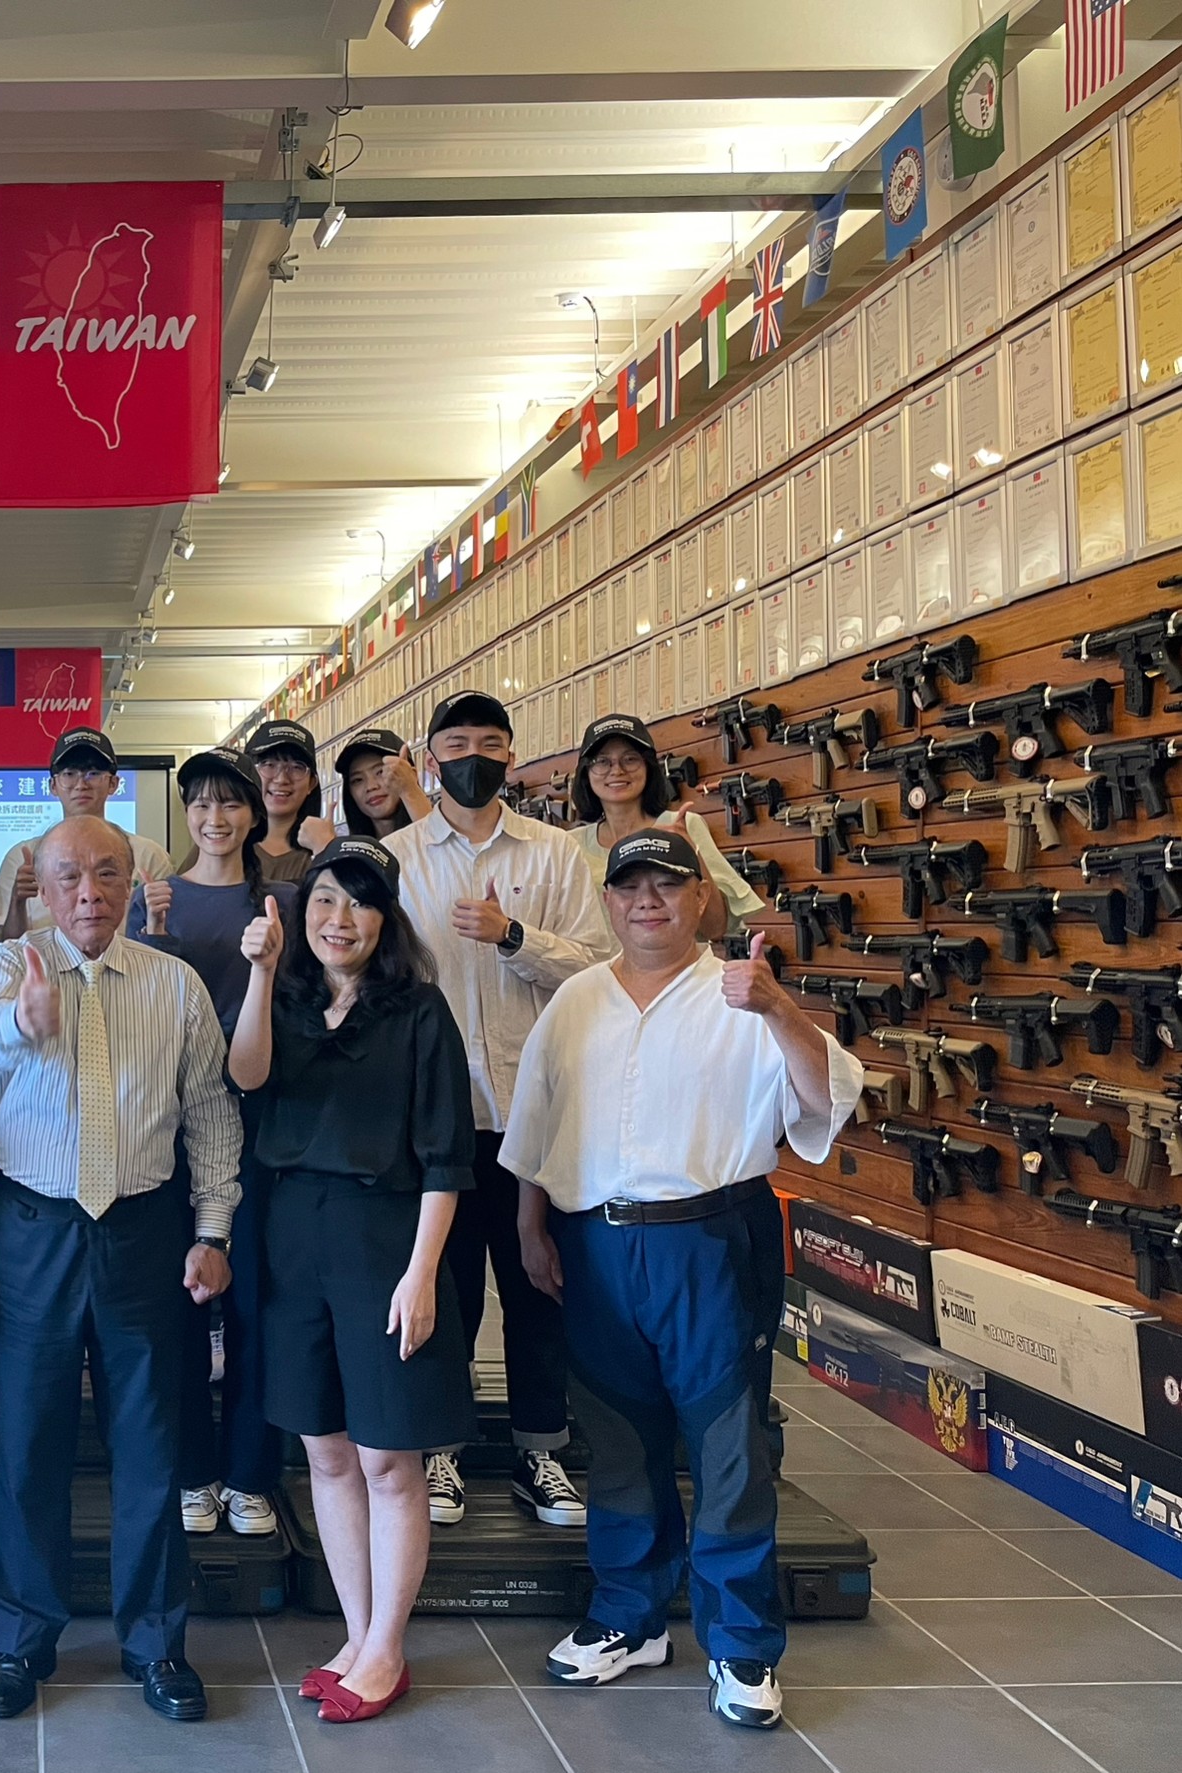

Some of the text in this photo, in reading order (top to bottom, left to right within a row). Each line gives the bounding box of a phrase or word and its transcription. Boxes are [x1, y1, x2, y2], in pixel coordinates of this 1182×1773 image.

[16, 314, 197, 352] TAIWAN
[22, 697, 92, 713] TAIWAN
[950, 1302, 976, 1326] COBALT
[989, 1323, 1015, 1348] BAMF
[1017, 1334, 1057, 1365] STEALTH
[825, 1361, 849, 1387] GK-12
[519, 1581, 538, 1589] 0328
[492, 1600, 510, 1608] 1005
